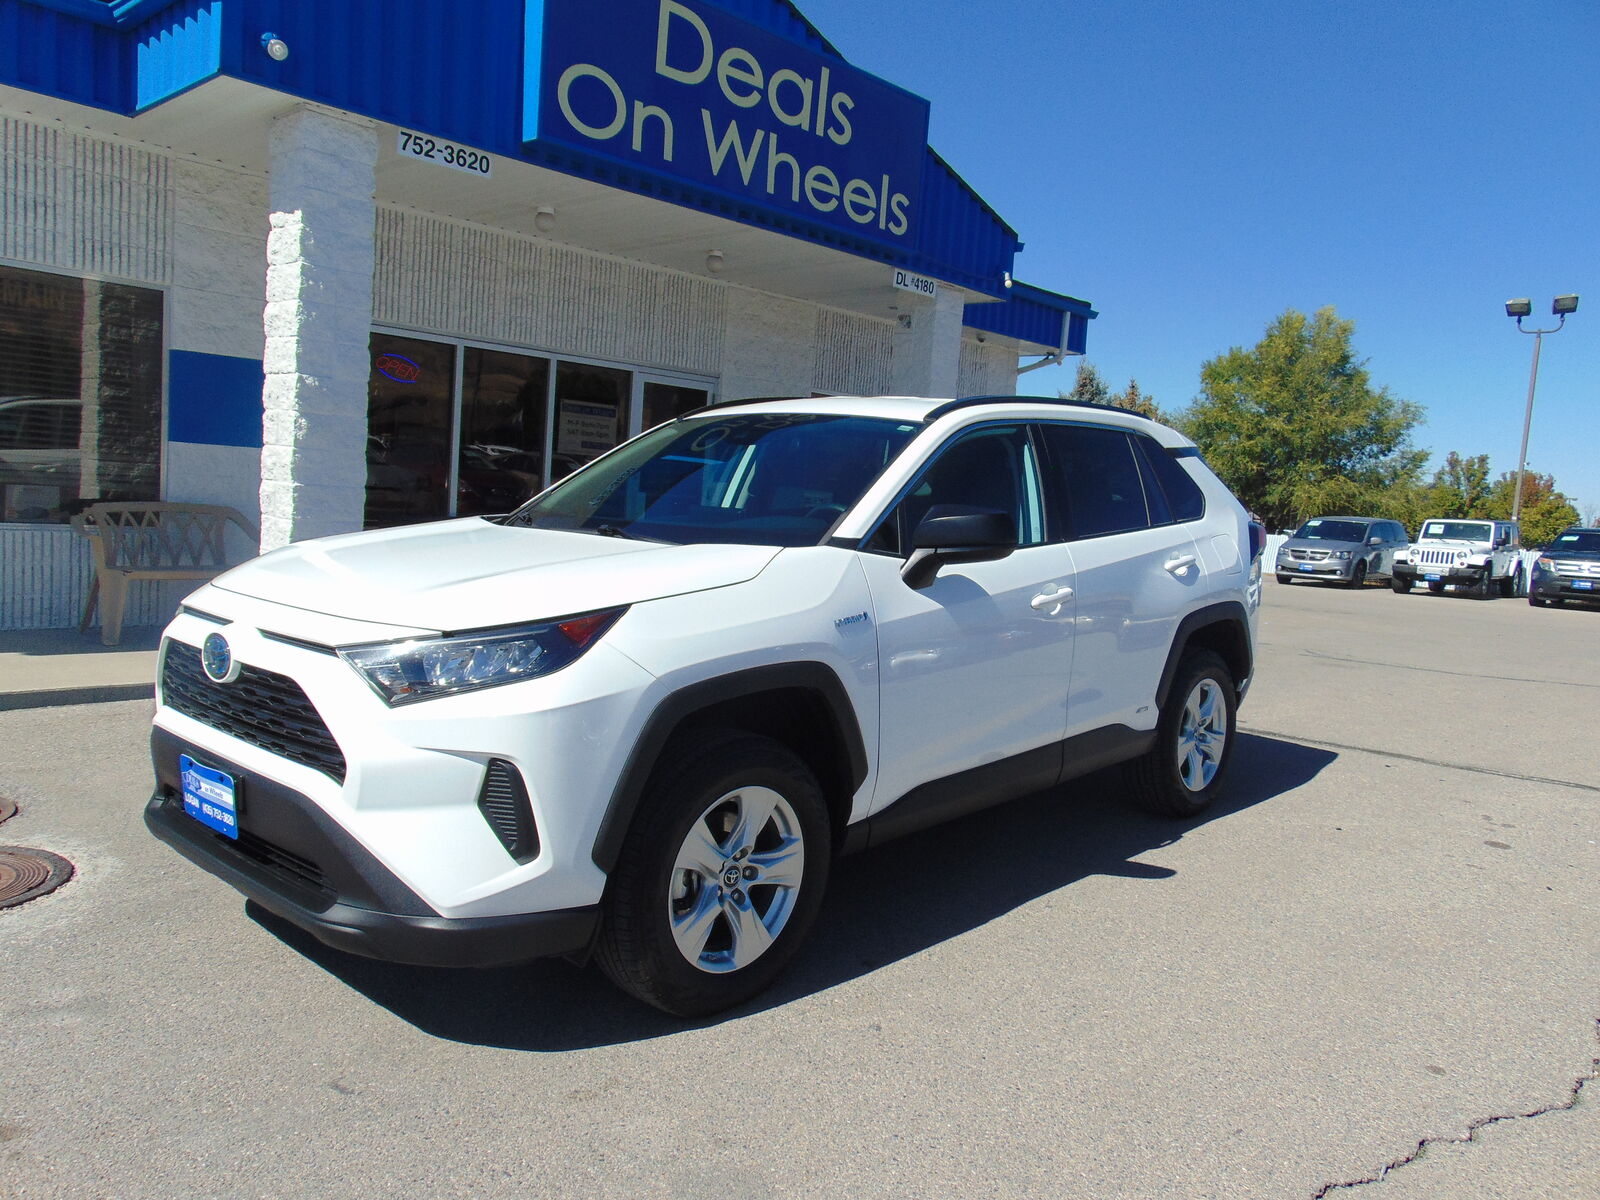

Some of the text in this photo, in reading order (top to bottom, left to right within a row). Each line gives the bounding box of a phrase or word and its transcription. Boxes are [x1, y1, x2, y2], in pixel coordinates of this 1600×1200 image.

[655, 0, 855, 145] Deals
[400, 130, 490, 174] 752-3620
[557, 63, 910, 236] On Wheels
[896, 272, 909, 287] DL
[375, 356, 421, 381] OPEN
